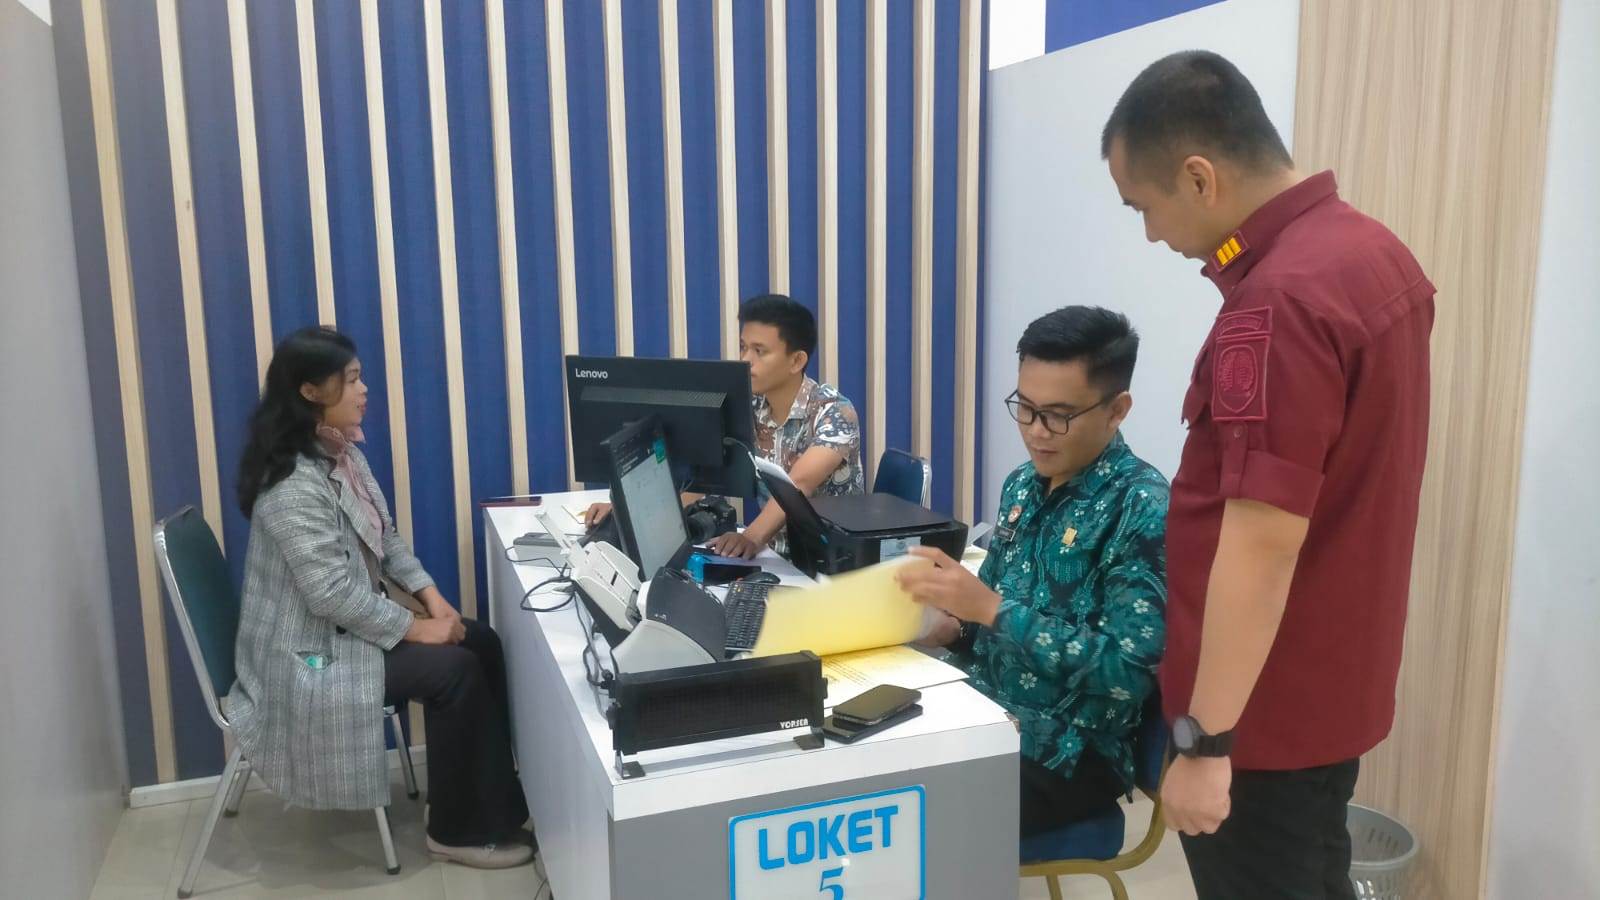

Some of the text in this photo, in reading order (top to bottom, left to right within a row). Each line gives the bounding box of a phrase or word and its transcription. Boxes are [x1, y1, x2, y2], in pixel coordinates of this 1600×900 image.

[575, 368, 608, 379] Lenovo
[758, 805, 899, 870] LOKET
[819, 866, 844, 900] 5
